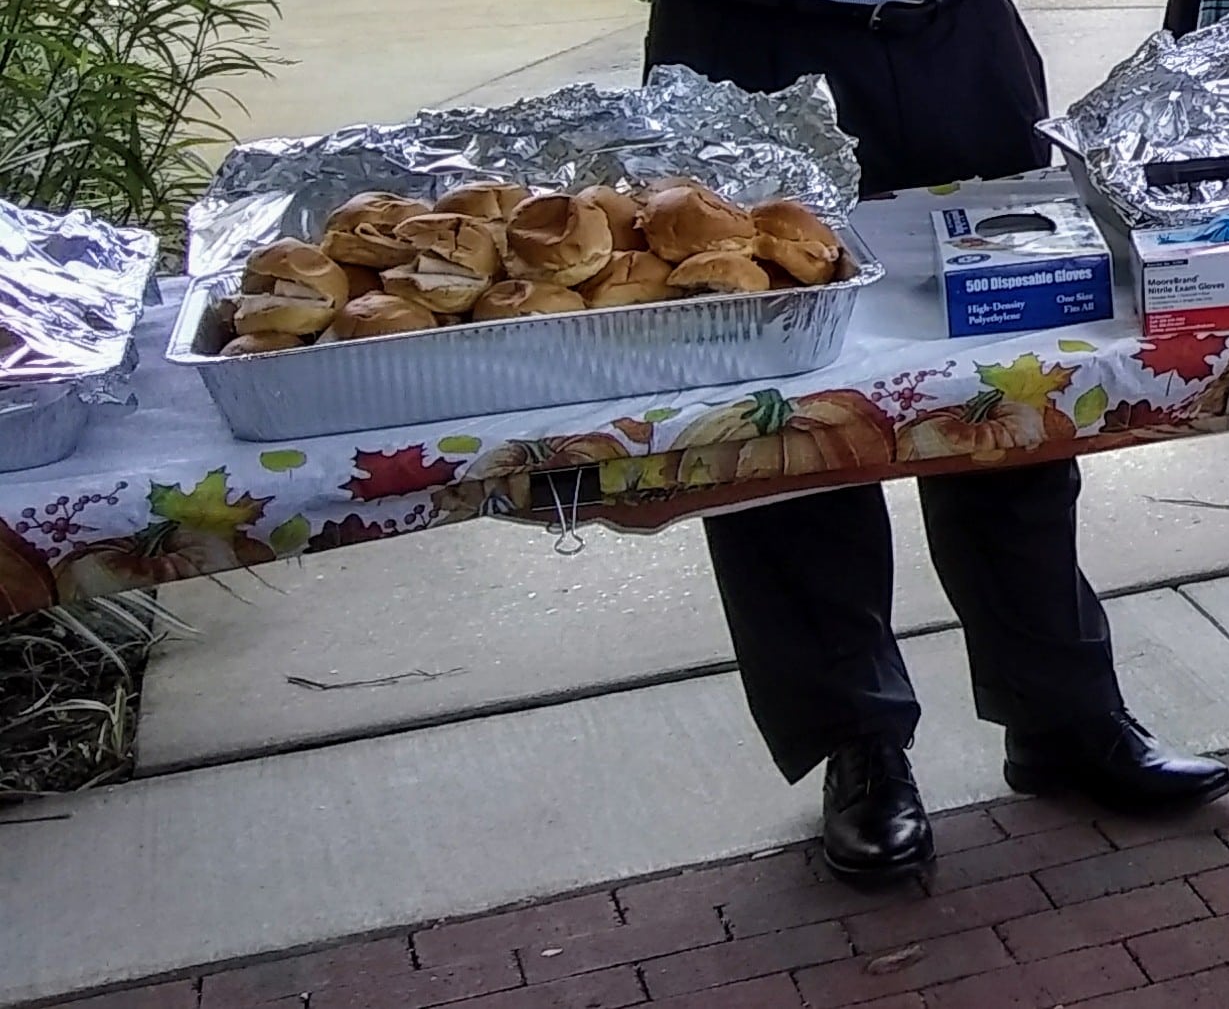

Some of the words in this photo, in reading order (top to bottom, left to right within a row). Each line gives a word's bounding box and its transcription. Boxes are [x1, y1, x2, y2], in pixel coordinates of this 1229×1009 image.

[966, 278, 989, 293] 500
[990, 273, 1053, 290] Disposable
[1054, 269, 1093, 283] Gloves
[1148, 286, 1173, 295] Nitrile
[1175, 284, 1197, 293] Exam
[1198, 282, 1225, 291] Gloves
[1056, 294, 1075, 304] One
[1076, 292, 1094, 302] Size
[967, 300, 1025, 315] High-Density
[1063, 304, 1080, 313] Fits
[1081, 302, 1094, 312] All
[968, 312, 1021, 325] Polyethylene
